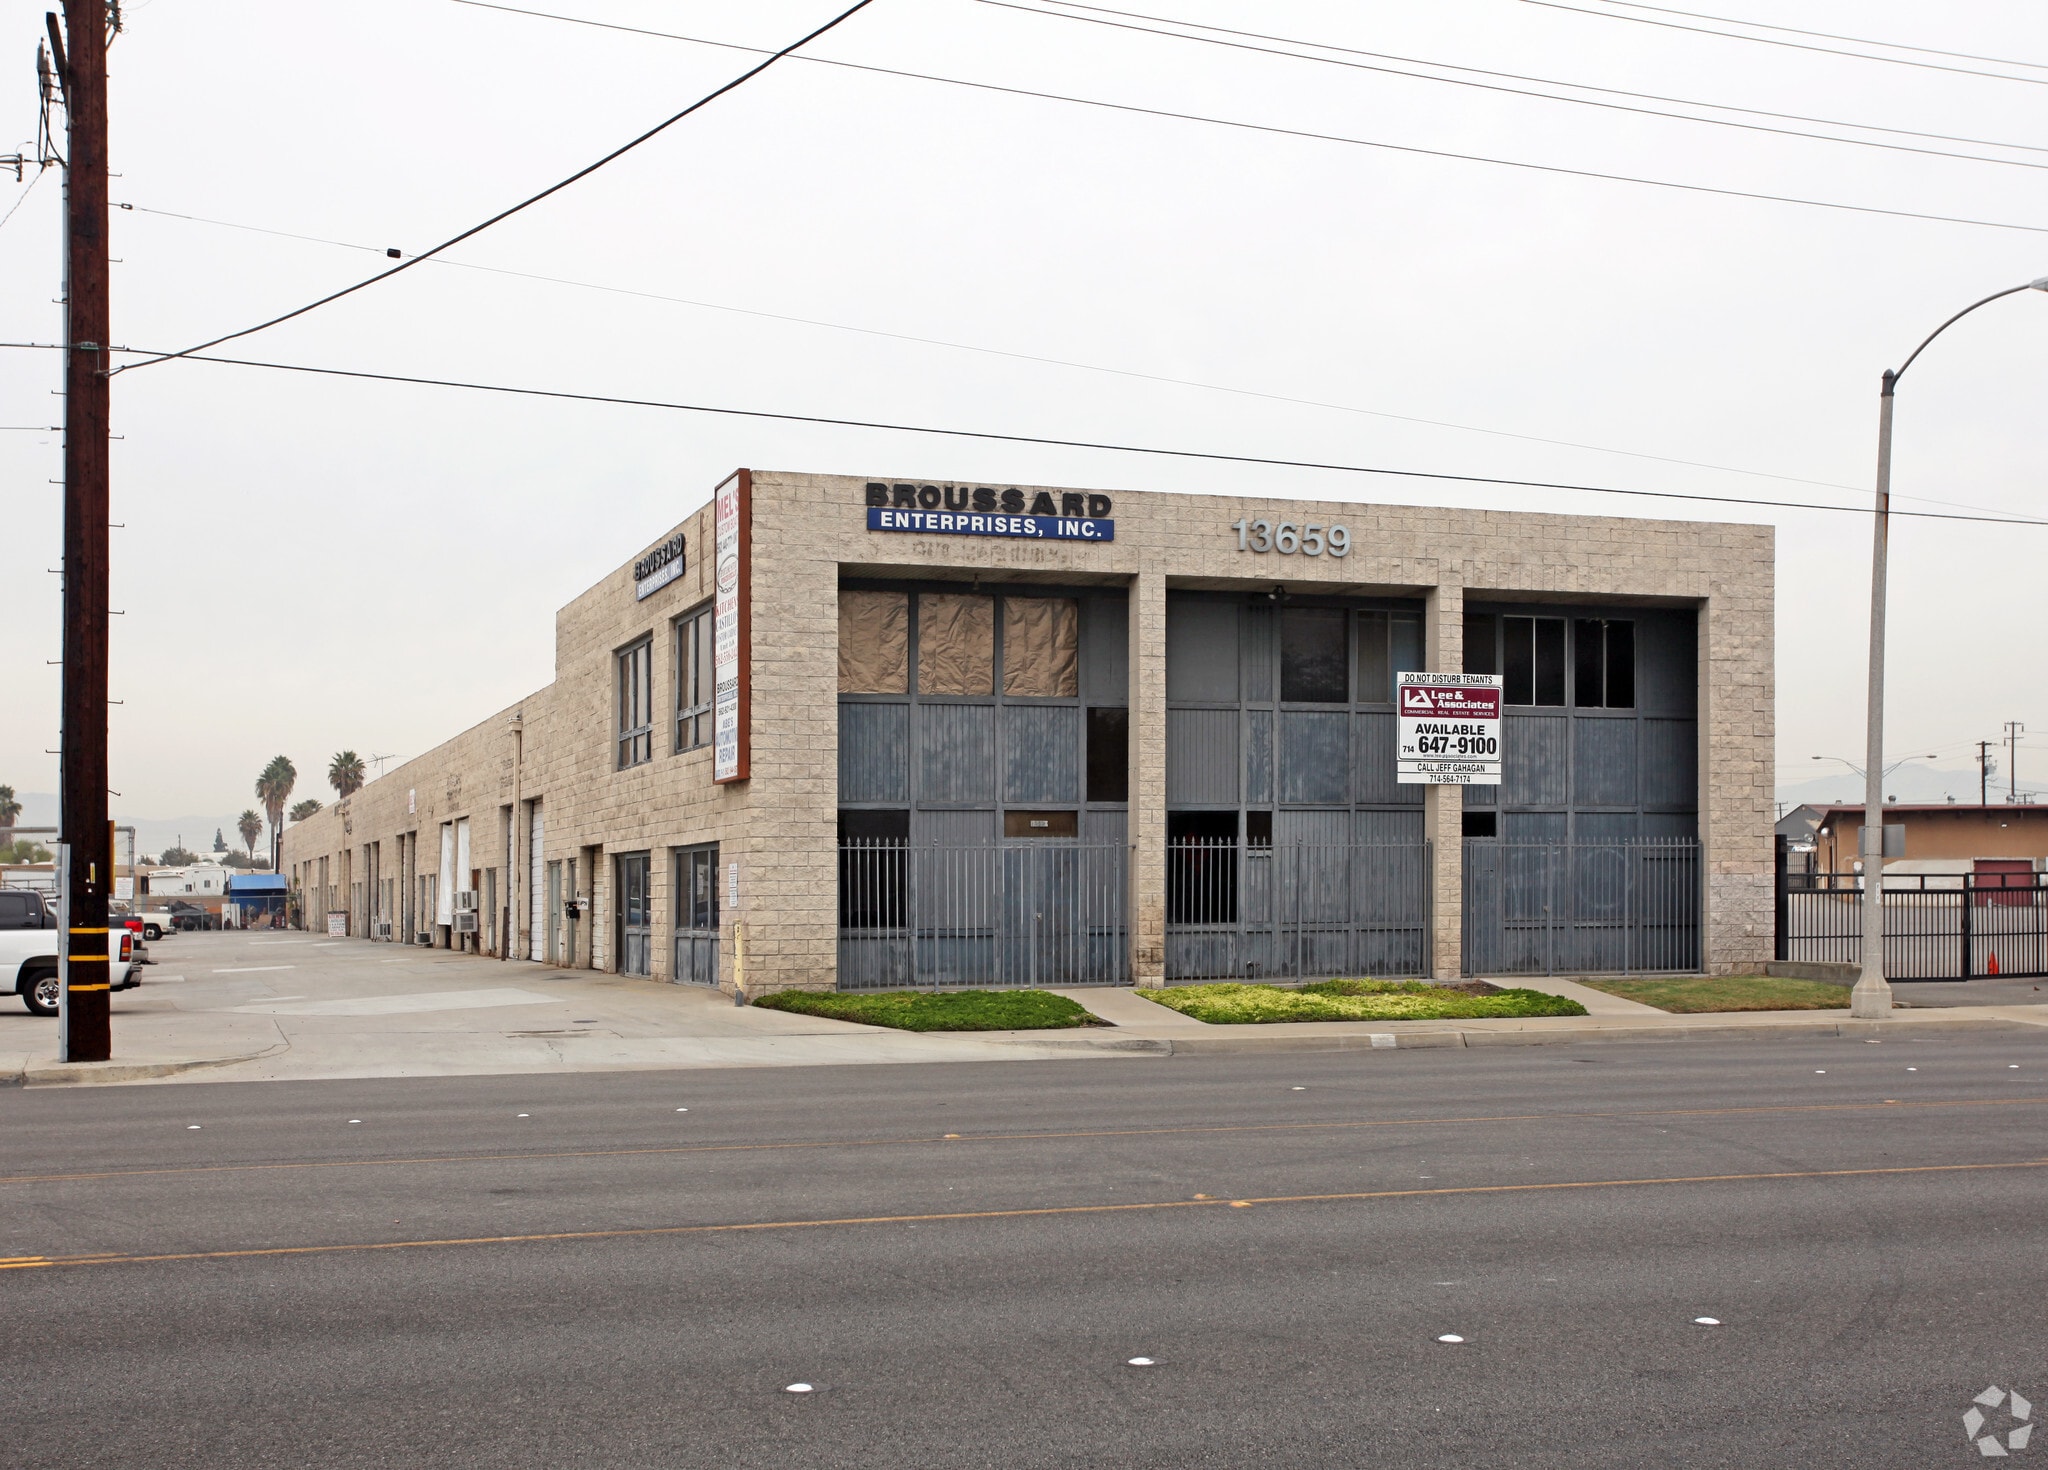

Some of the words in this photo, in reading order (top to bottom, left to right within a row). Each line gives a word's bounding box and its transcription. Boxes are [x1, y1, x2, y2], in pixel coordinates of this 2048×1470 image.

[866, 483, 1112, 517] BROUSSARD
[880, 511, 1044, 537] ENTERPRISES,
[1057, 520, 1102, 537] INC.
[1231, 518, 1351, 558] 13659
[634, 533, 686, 581] BROUSSARD
[1405, 674, 1414, 682] DO
[1417, 674, 1430, 683] NOT
[1432, 674, 1460, 683] DISTURB
[1463, 675, 1493, 684] TENANTS
[1431, 690, 1453, 700] Lee
[1454, 691, 1464, 700] &
[1437, 700, 1495, 710] Associates
[1415, 723, 1485, 735] AVAILABLE
[1403, 745, 1415, 753] 714
[1418, 736, 1497, 754] 647-9100
[1417, 763, 1434, 772] CALL
[1436, 763, 1451, 772] JEFF
[1453, 764, 1485, 772] GAHAGAN
[1430, 774, 1470, 783] 714-564-7174
